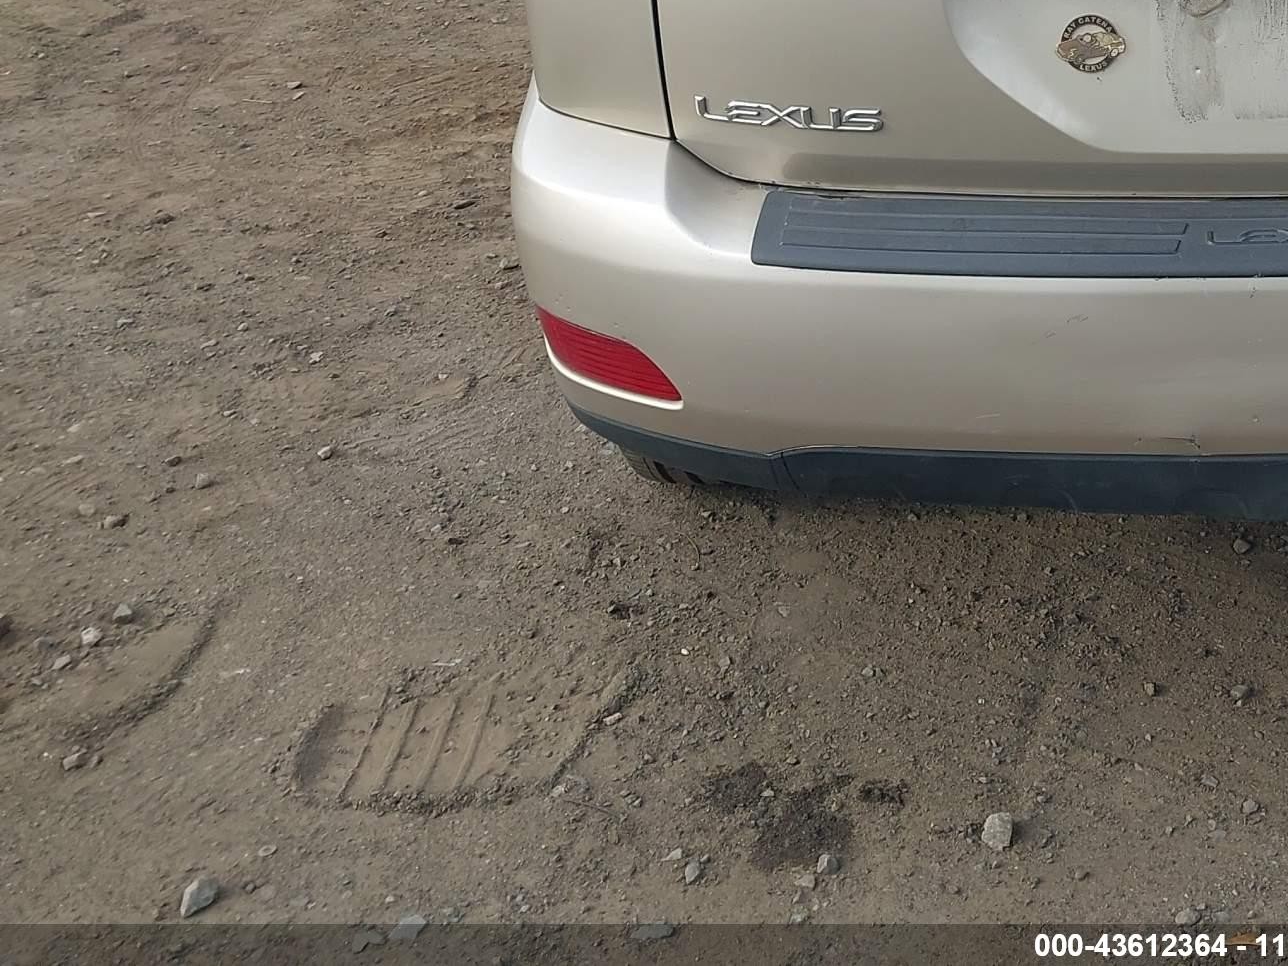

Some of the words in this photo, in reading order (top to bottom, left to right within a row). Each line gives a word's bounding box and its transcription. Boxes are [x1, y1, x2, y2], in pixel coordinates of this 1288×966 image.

[1078, 16, 1113, 33] CATENA
[1080, 61, 1108, 72] LEXUS
[694, 94, 884, 132] LEXUS
